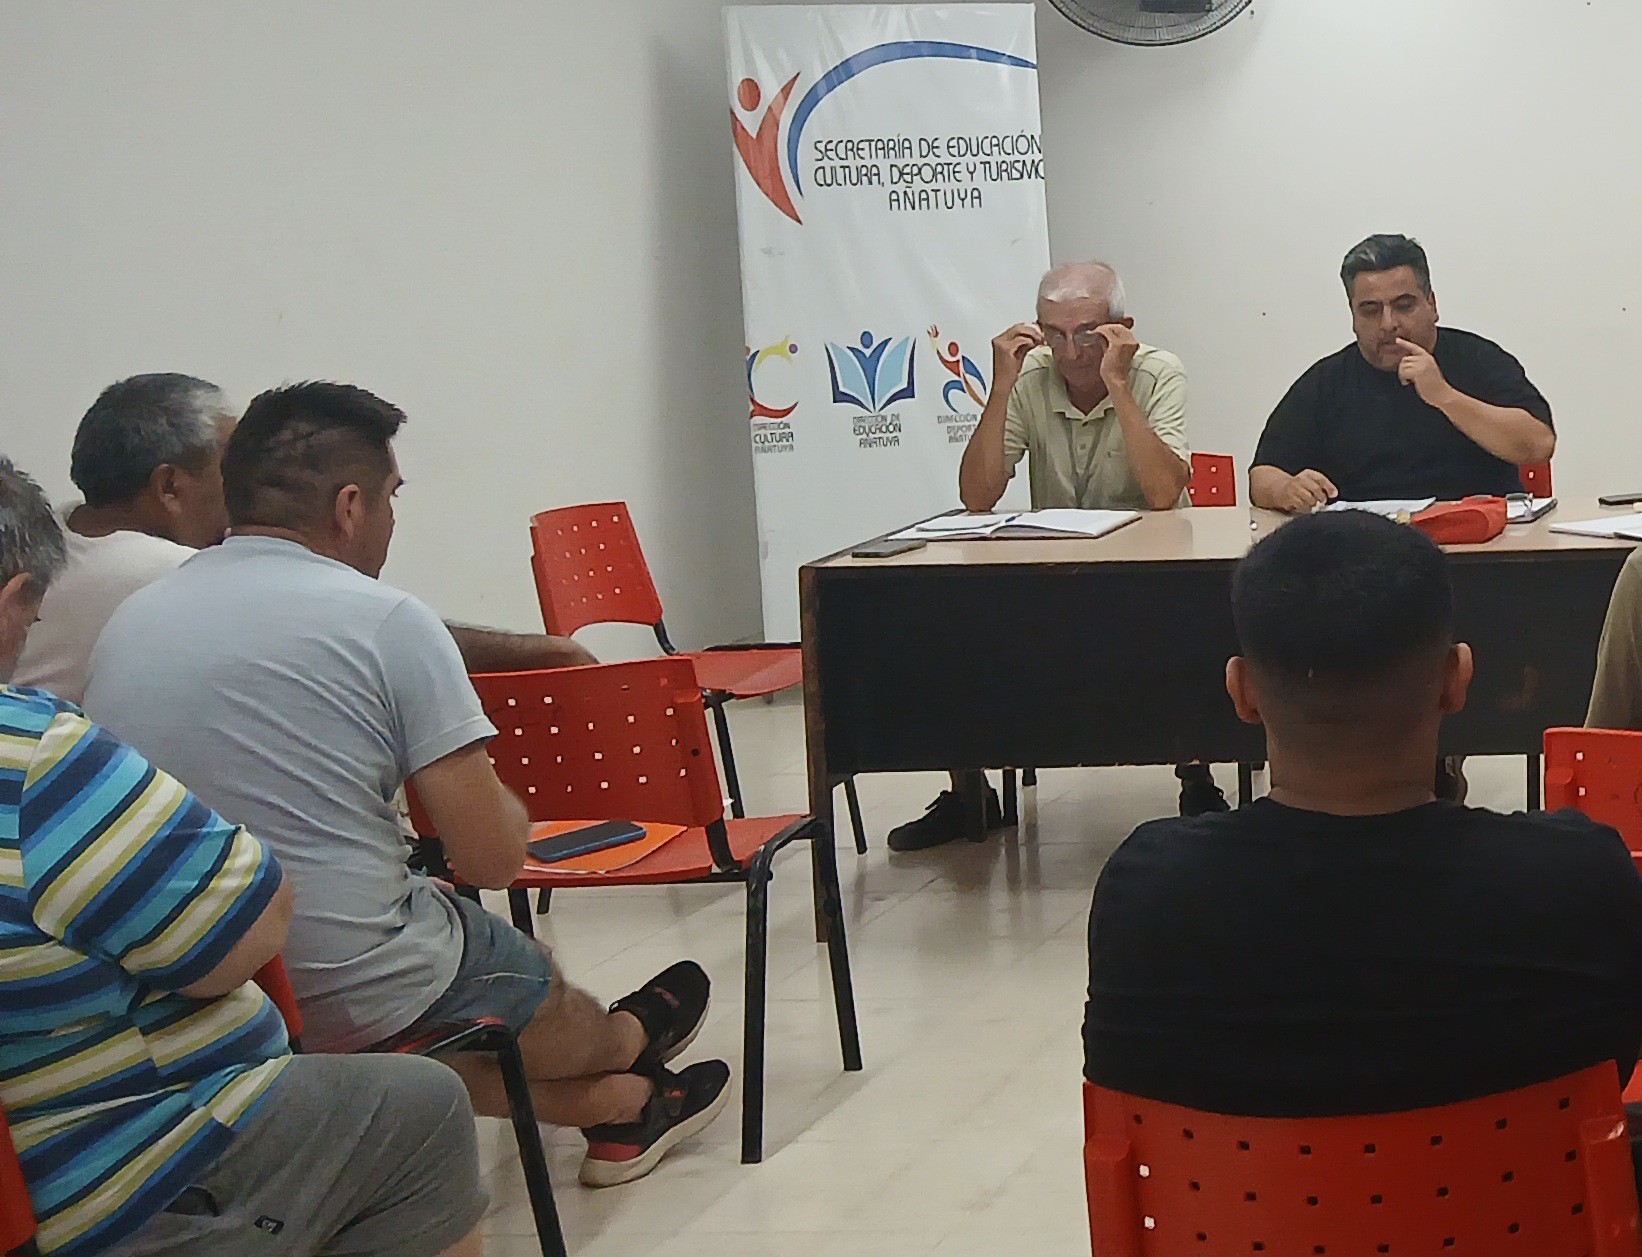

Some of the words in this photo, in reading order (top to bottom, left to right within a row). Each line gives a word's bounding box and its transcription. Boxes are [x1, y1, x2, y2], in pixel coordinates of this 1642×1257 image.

[813, 134, 913, 162] SECRETARÍA
[918, 137, 941, 159] DE
[946, 129, 1042, 158] EDUCACIÓN
[813, 164, 885, 187] CULTURA,
[889, 161, 962, 184] DEPORTE
[966, 161, 976, 182] Y
[889, 186, 982, 211] AÑATUYA
[754, 431, 794, 445] CULTURA
